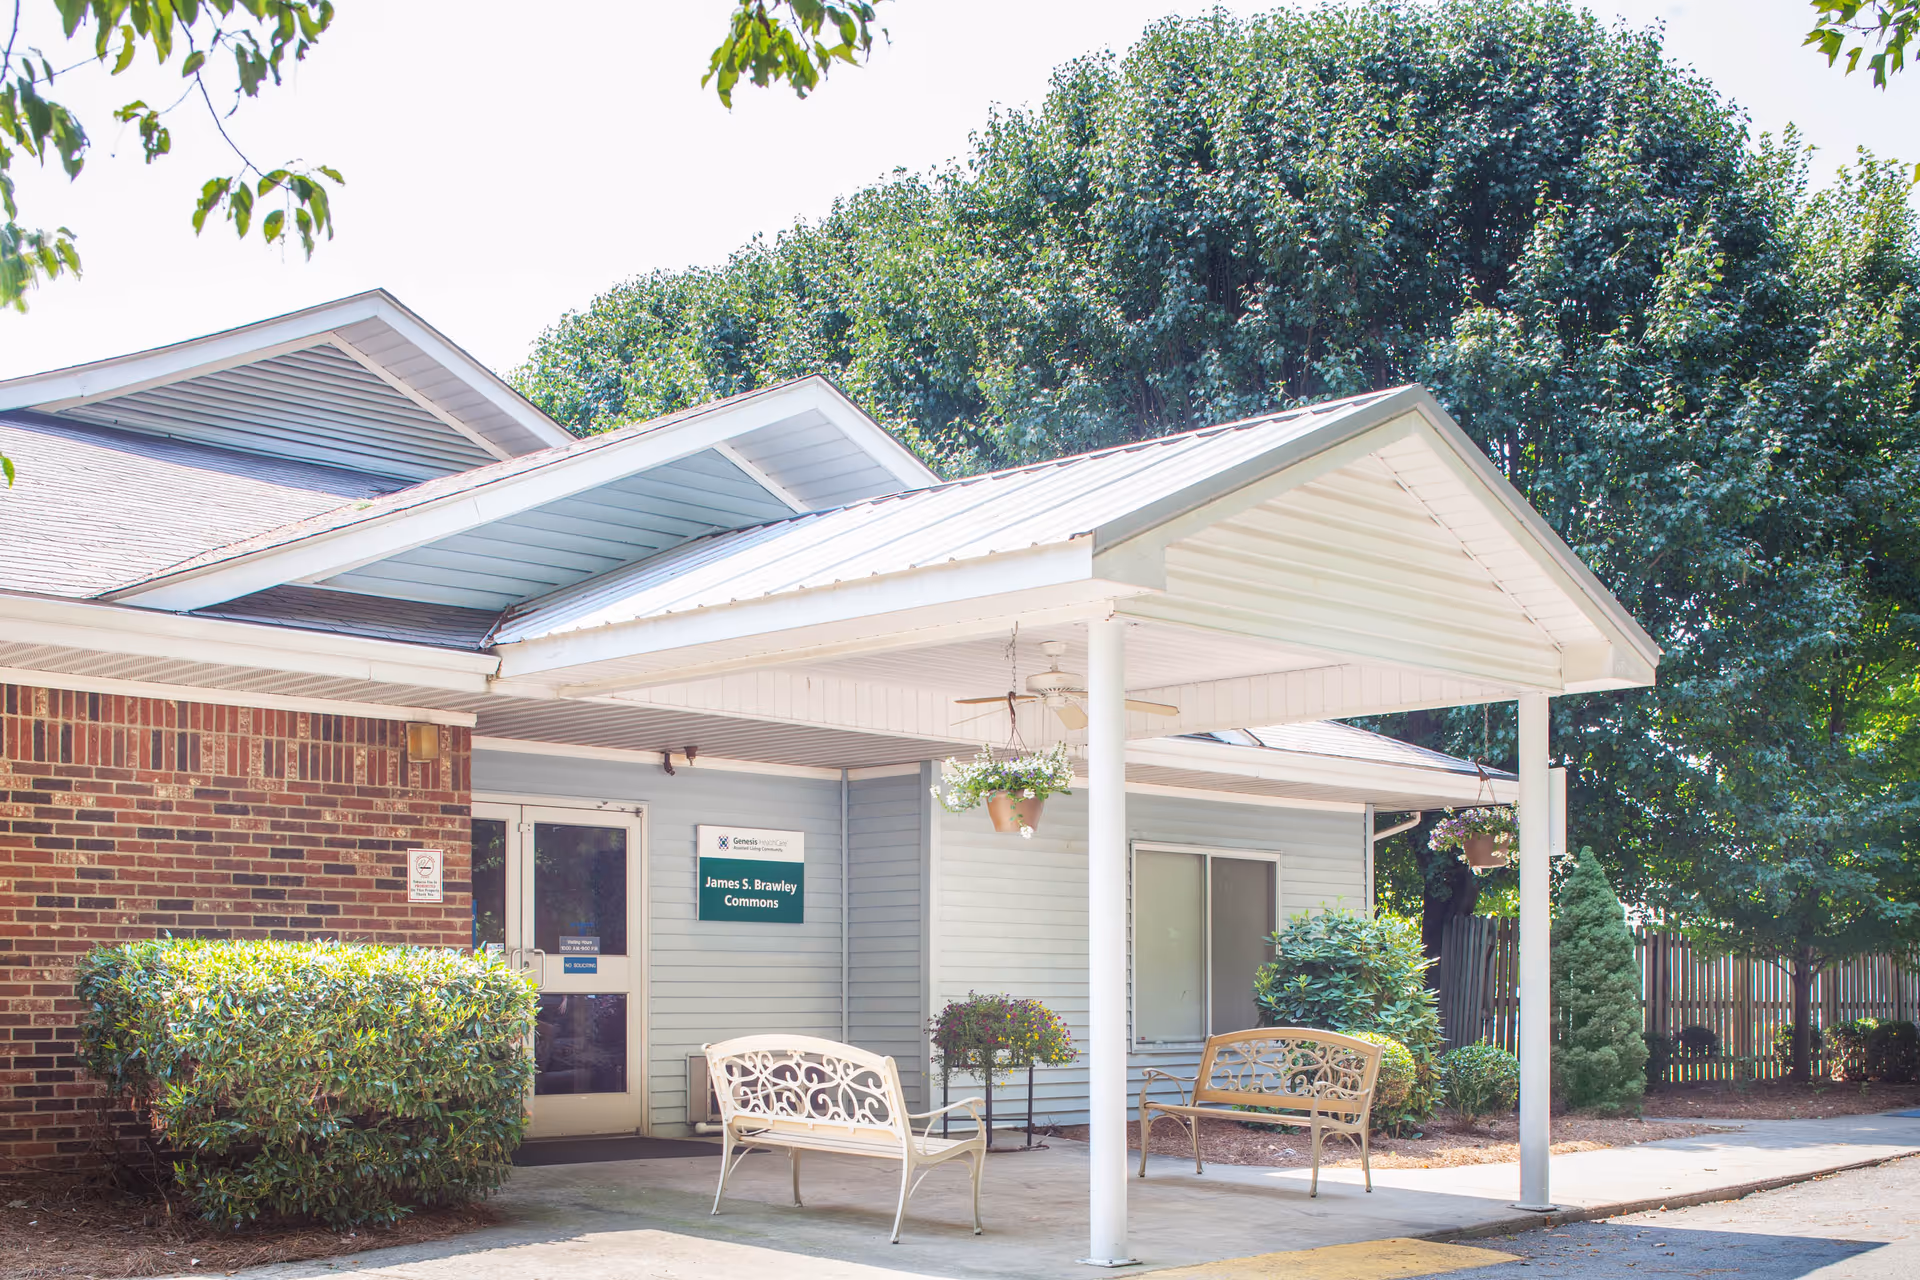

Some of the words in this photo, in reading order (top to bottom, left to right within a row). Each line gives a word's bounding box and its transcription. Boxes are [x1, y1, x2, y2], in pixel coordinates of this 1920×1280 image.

[733, 837, 758, 846] Genesis
[705, 876, 740, 889] James
[742, 878, 752, 890] S.
[754, 879, 797, 896] Brawley
[724, 894, 779, 909] Commons
